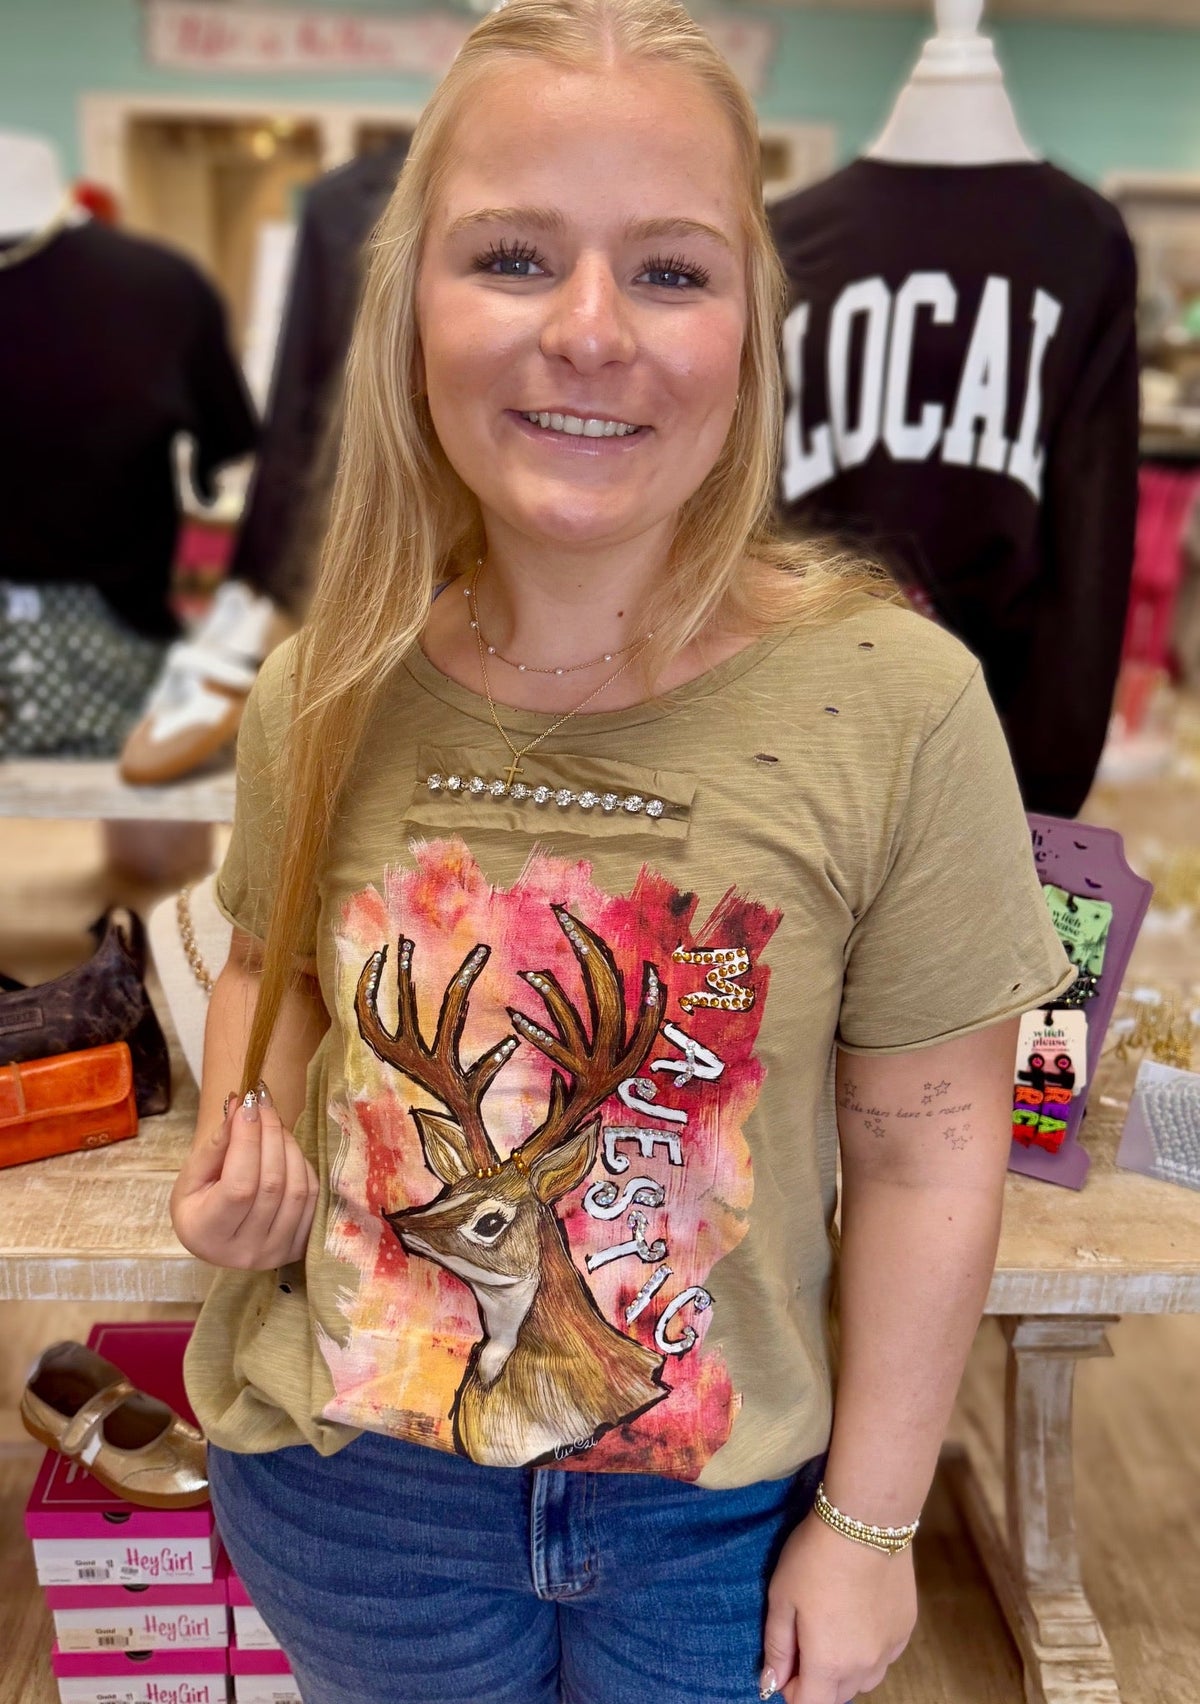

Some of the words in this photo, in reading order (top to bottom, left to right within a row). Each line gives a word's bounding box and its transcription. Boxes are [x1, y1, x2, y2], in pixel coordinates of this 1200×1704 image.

[783, 271, 1062, 502] LOCAL
[1032, 1029, 1065, 1038] witch
[1032, 1037, 1067, 1048] please
[582, 945, 754, 1356] MAJESTIC
[126, 1547, 193, 1576] HeyGirl
[144, 1614, 210, 1642] HeyGirl
